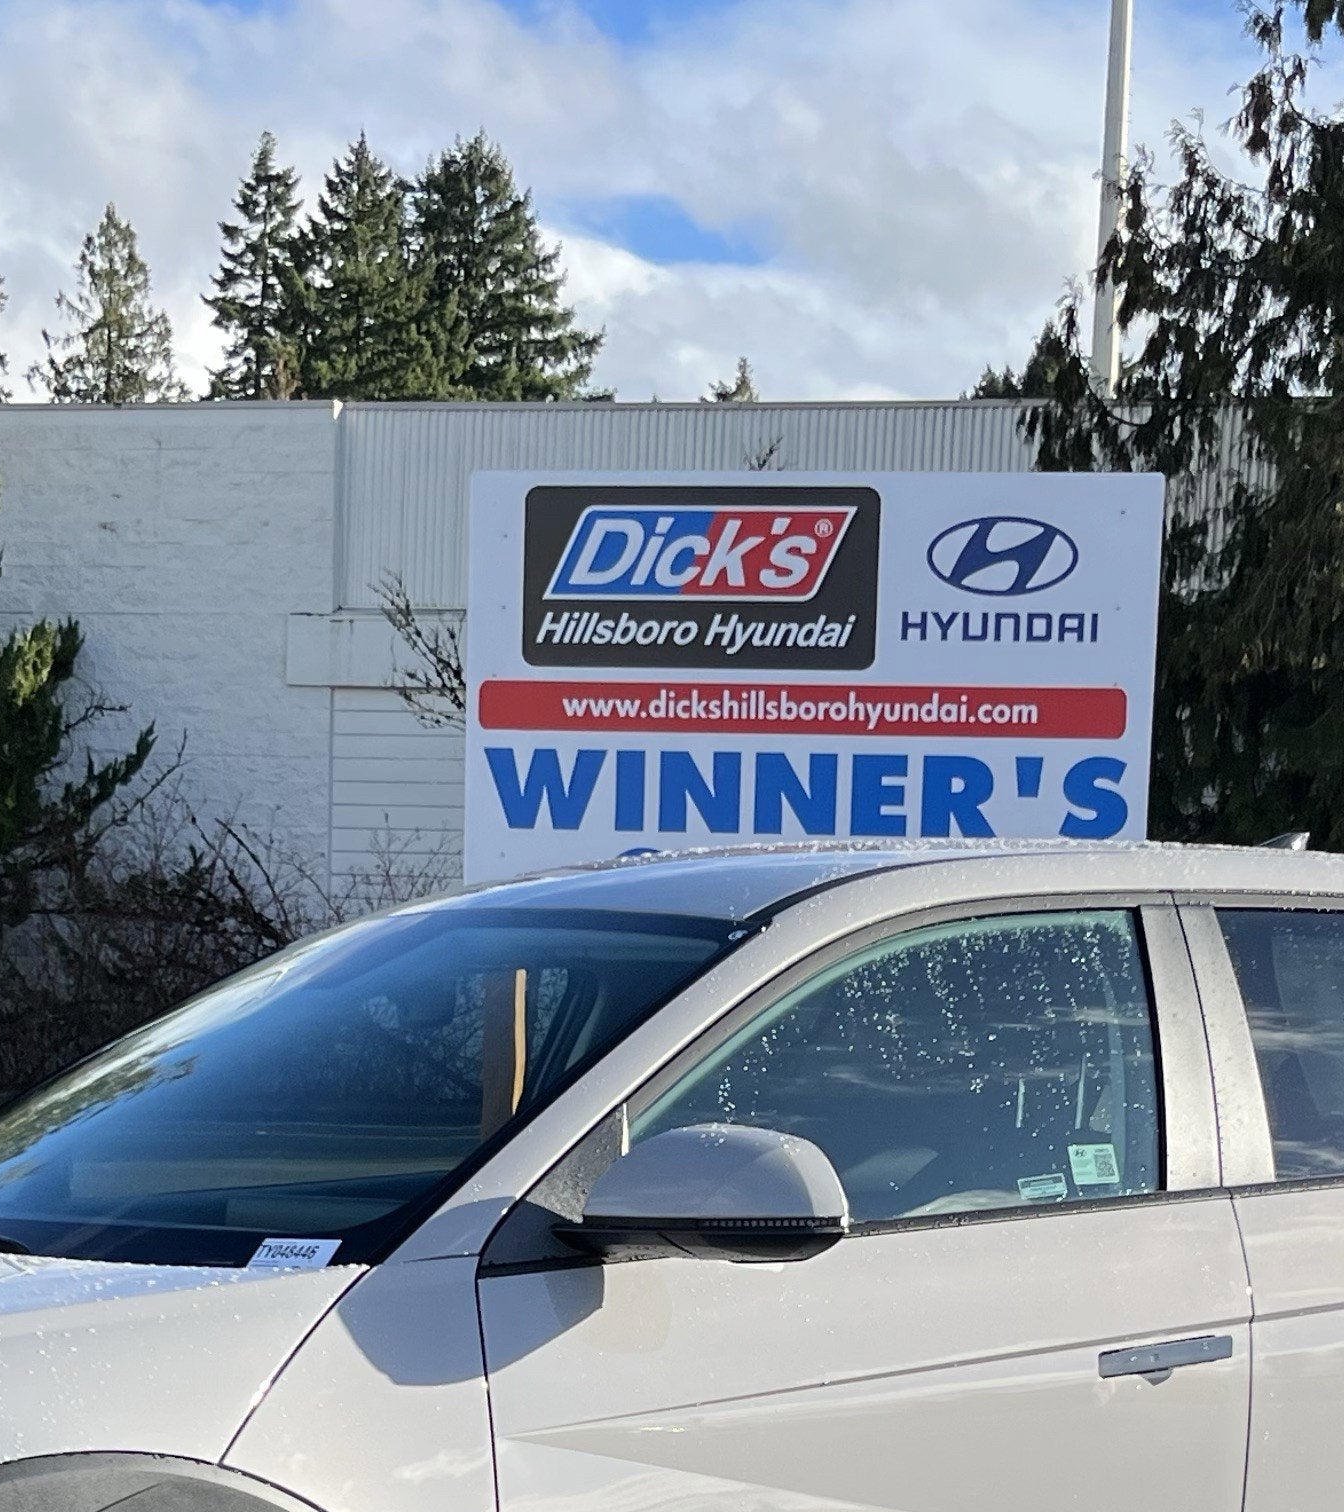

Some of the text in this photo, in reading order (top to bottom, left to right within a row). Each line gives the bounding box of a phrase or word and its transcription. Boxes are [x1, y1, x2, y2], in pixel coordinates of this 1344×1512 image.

[536, 612, 856, 654] Hillsboro Hyundai
[901, 611, 1099, 643] HYUNDAI
[562, 689, 1039, 730] www.dickshillsborohyundai.com
[483, 747, 1129, 840] WINNER'S
